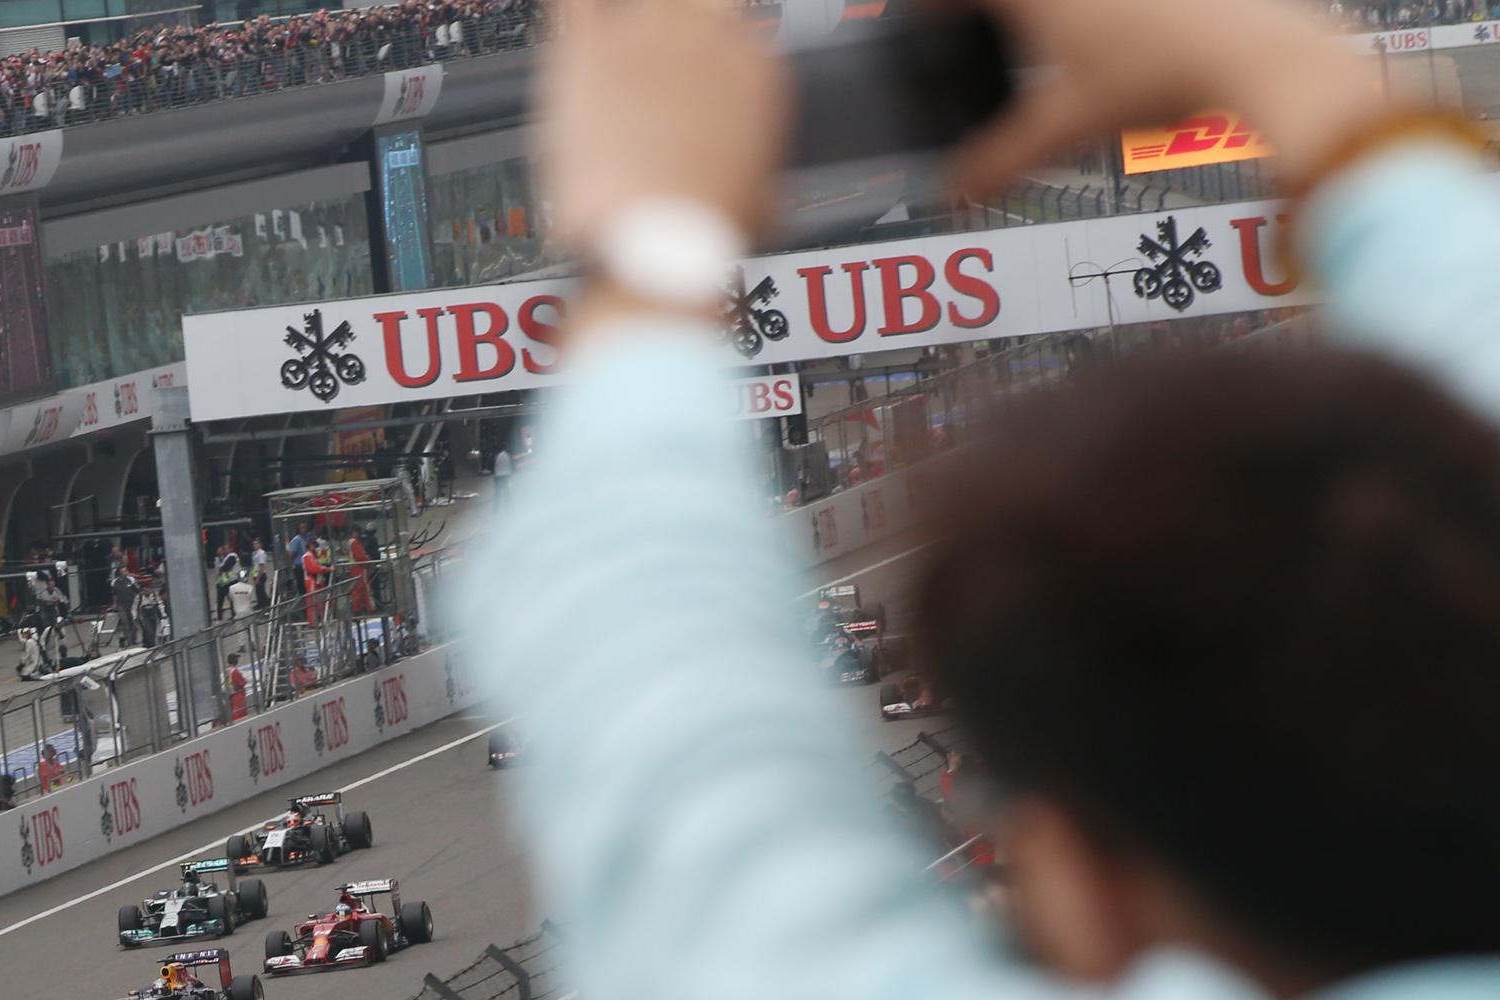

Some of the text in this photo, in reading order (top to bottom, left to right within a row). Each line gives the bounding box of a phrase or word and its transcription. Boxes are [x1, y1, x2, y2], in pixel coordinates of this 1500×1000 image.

[1390, 31, 1428, 50] UBS
[1164, 114, 1268, 156] DH
[10, 142, 41, 188] UBS
[797, 247, 1002, 344] UBS
[373, 295, 568, 388] UBS
[322, 697, 349, 751] UBS
[382, 673, 408, 726] UBS
[257, 721, 285, 777] UBS
[184, 749, 214, 807] UBS
[110, 777, 142, 837] UBS
[31, 805, 64, 867] UBS
[175, 949, 219, 961] INFNIT
